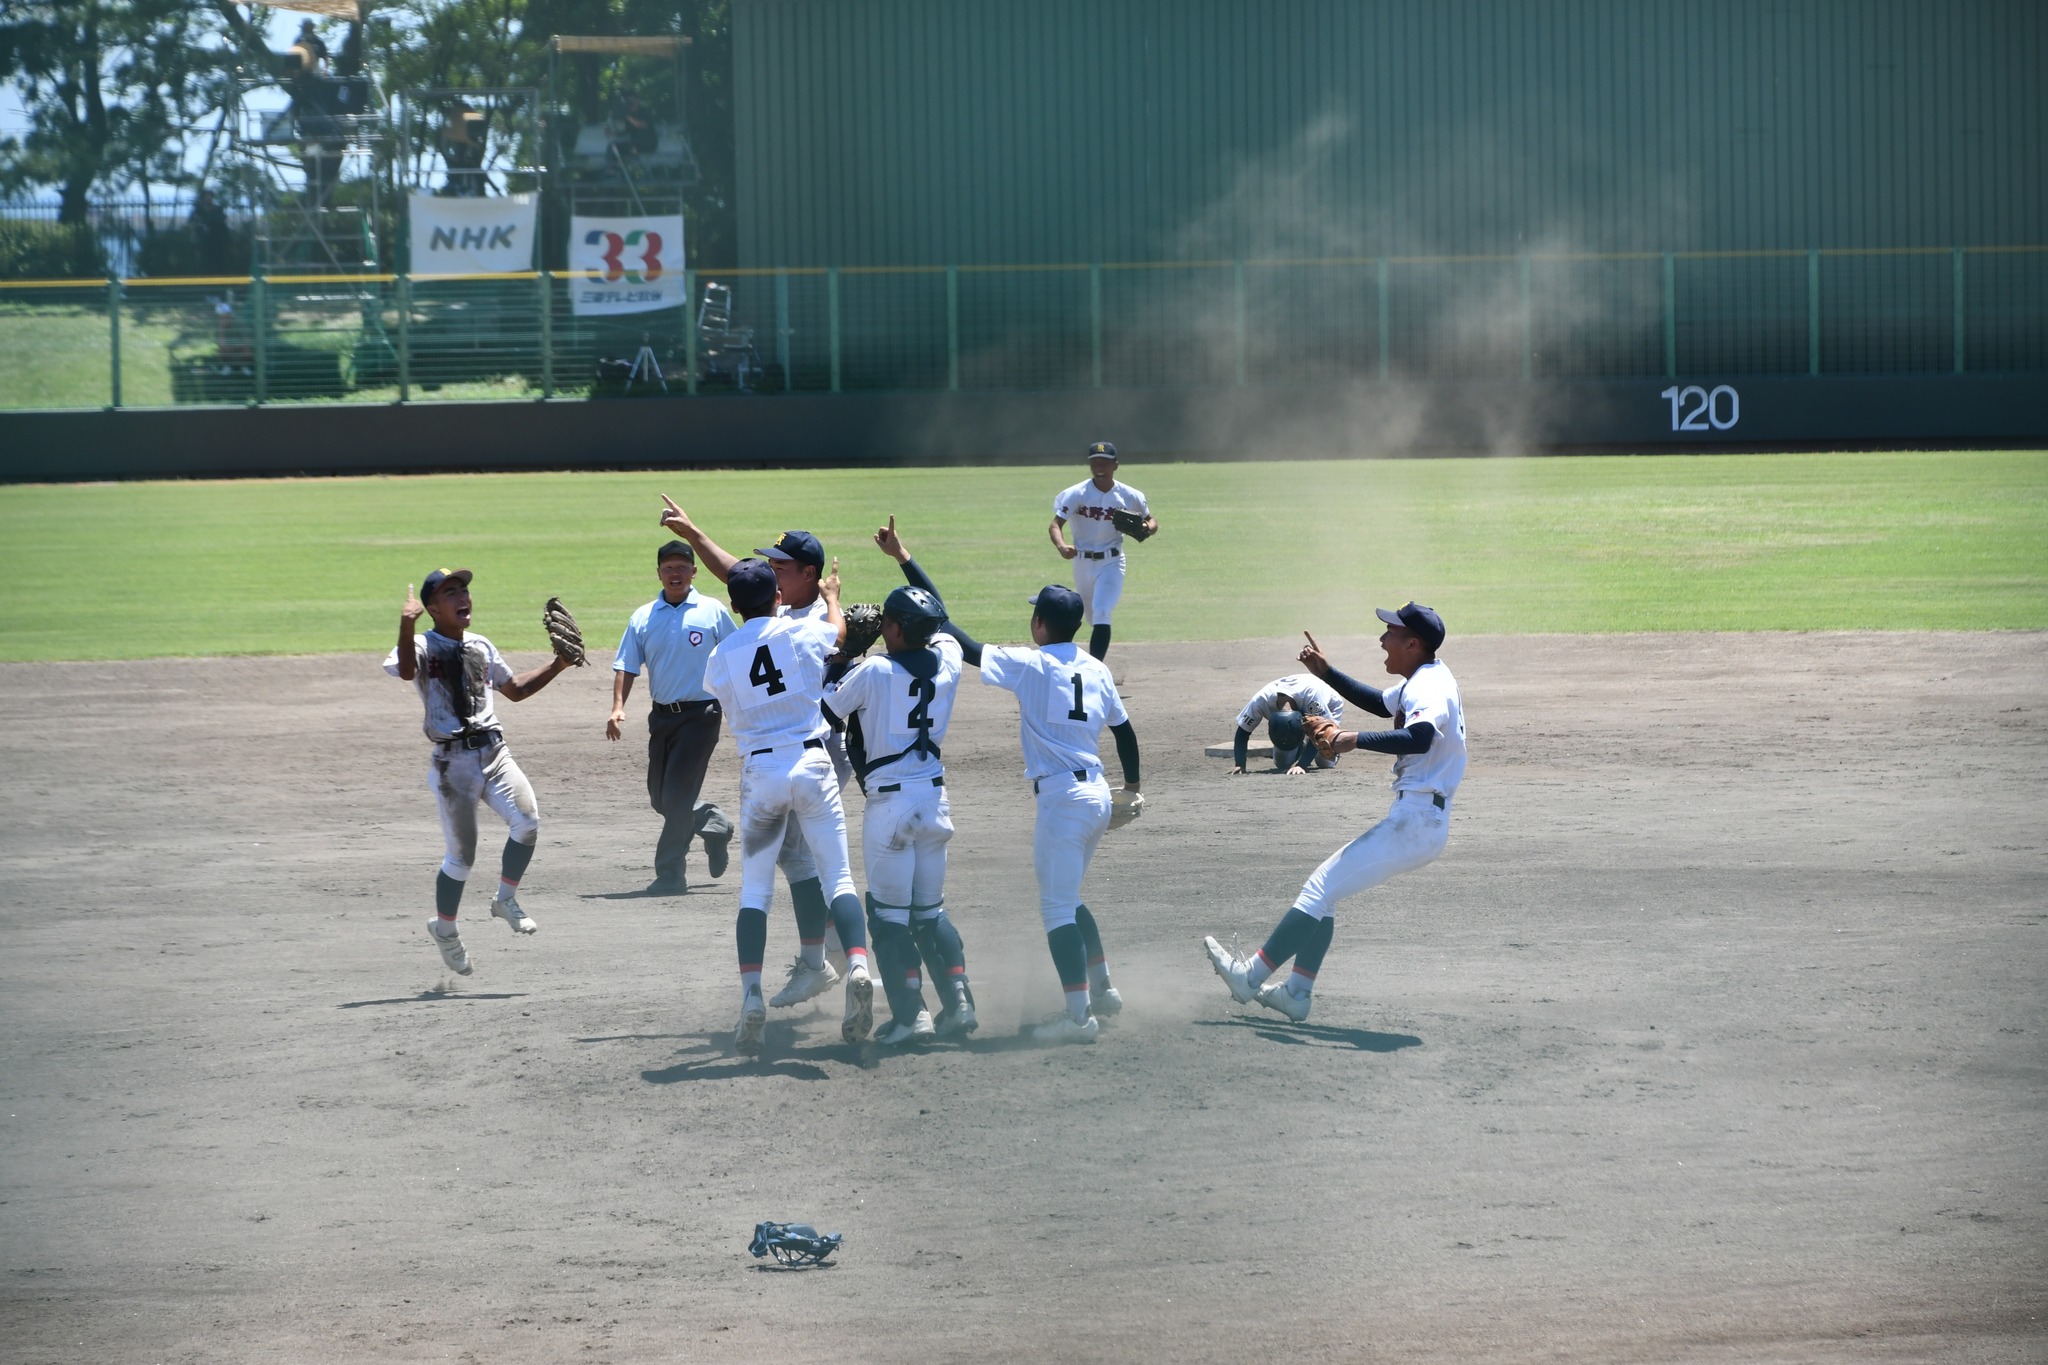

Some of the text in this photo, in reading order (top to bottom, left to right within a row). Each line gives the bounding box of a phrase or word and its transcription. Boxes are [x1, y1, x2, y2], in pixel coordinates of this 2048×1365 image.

[429, 225, 517, 251] NHK
[584, 230, 663, 284] 33
[1661, 384, 1740, 431] 120
[749, 644, 787, 697] 4
[907, 678, 936, 730] 2
[1067, 672, 1089, 722] 1
